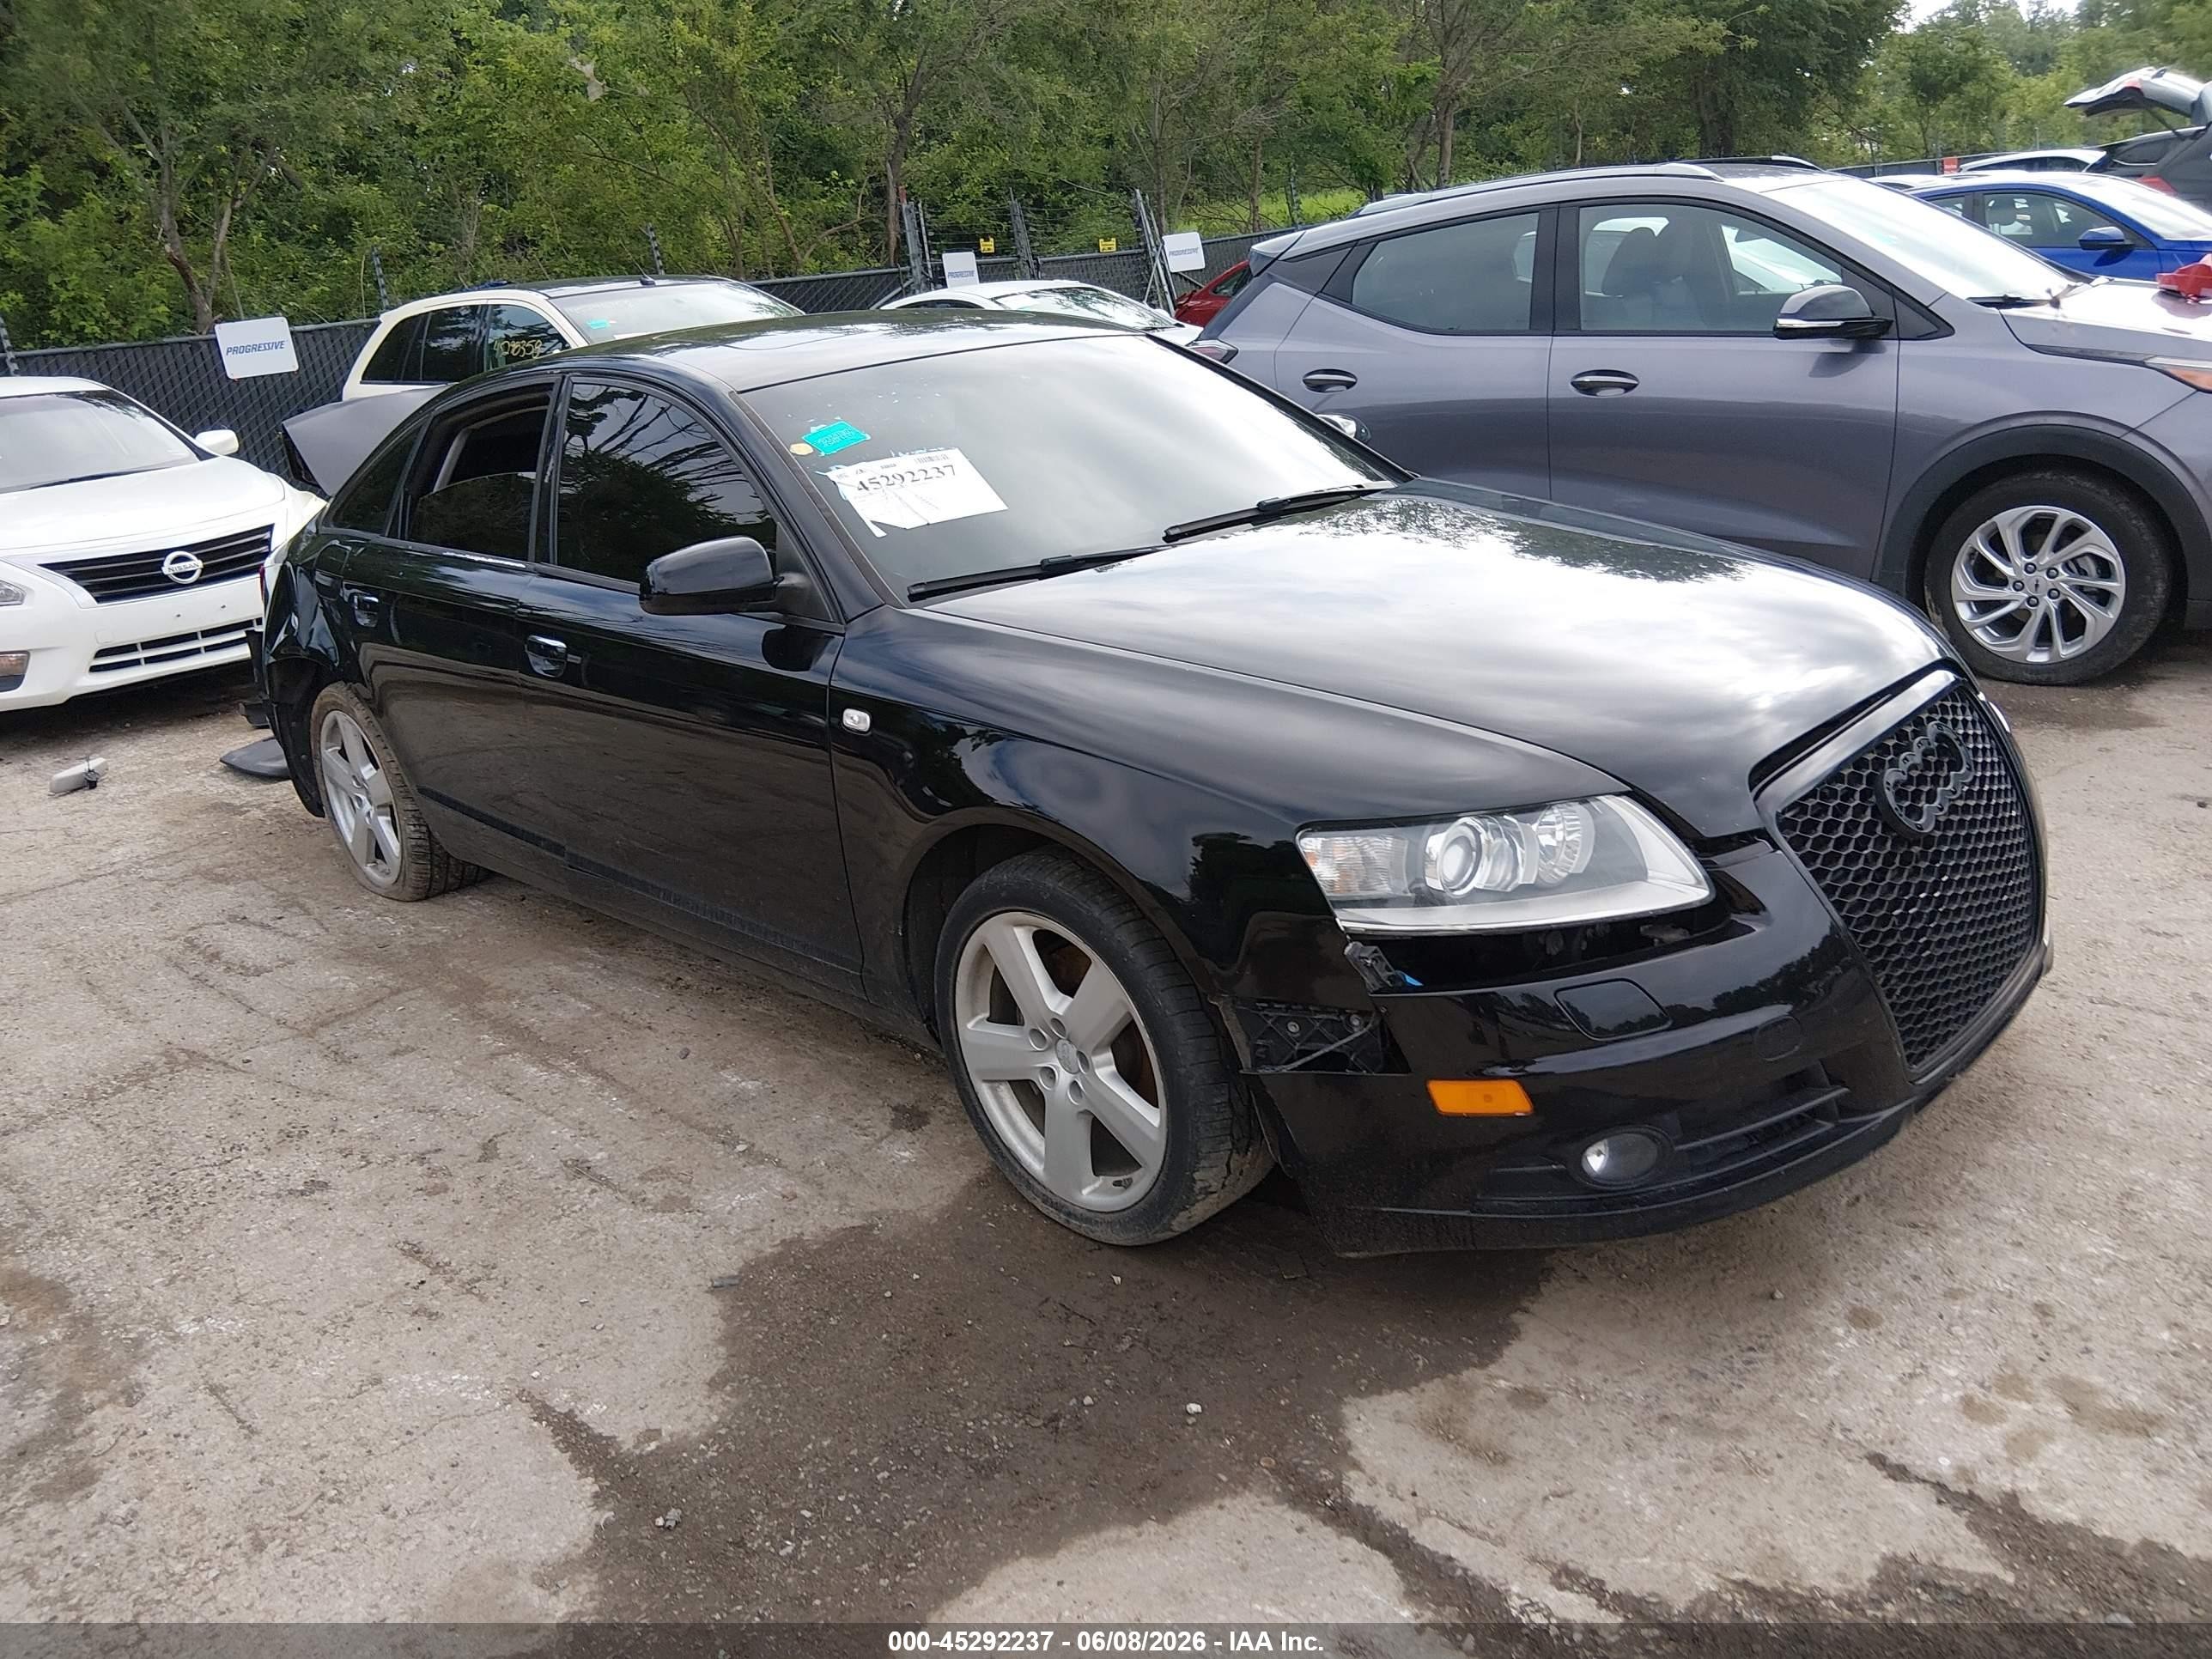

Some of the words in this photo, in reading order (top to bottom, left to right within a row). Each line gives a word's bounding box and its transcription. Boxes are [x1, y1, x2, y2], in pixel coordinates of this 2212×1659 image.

[225, 340, 286, 356] PROGRESSIVE
[856, 465, 956, 491] 45292237
[167, 562, 200, 573] NISSAN
